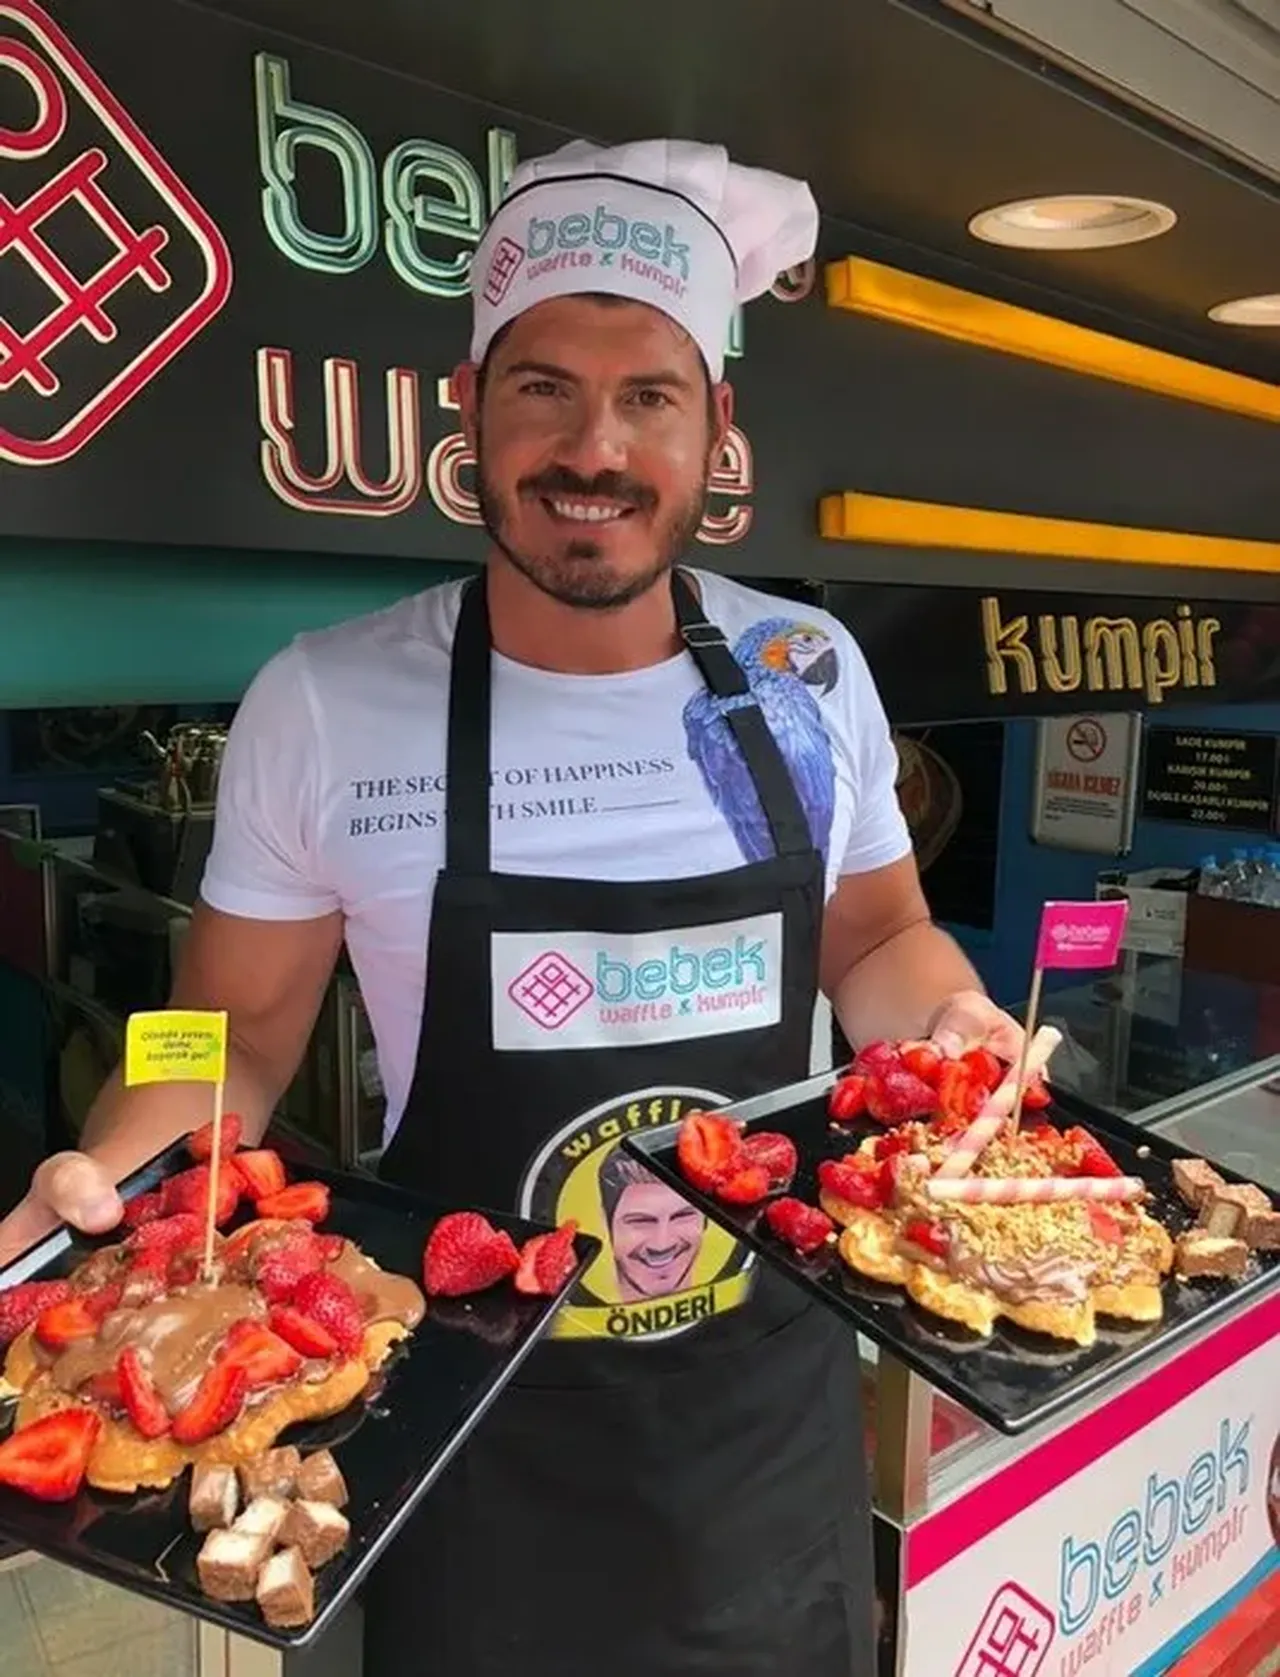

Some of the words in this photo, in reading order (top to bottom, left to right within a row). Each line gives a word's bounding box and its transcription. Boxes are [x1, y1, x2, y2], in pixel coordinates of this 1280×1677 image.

[527, 205, 690, 281] bebek
[526, 250, 592, 281] waffle
[620, 250, 688, 299] kumpir
[981, 596, 1221, 703] kumpir
[351, 776, 401, 799] THE
[504, 768, 538, 787] OF
[542, 756, 676, 785] HAPPINESS
[349, 810, 437, 837] BEGINS
[521, 796, 597, 819] SMILE
[596, 935, 766, 1002] bebek
[600, 1001, 673, 1025] waffle
[696, 984, 767, 1014] kumpir
[606, 1286, 715, 1337] ÖNDERİ
[1058, 1417, 1251, 1637] bebek
[1060, 1592, 1142, 1677] waffle
[1171, 1503, 1249, 1591] kumpir
